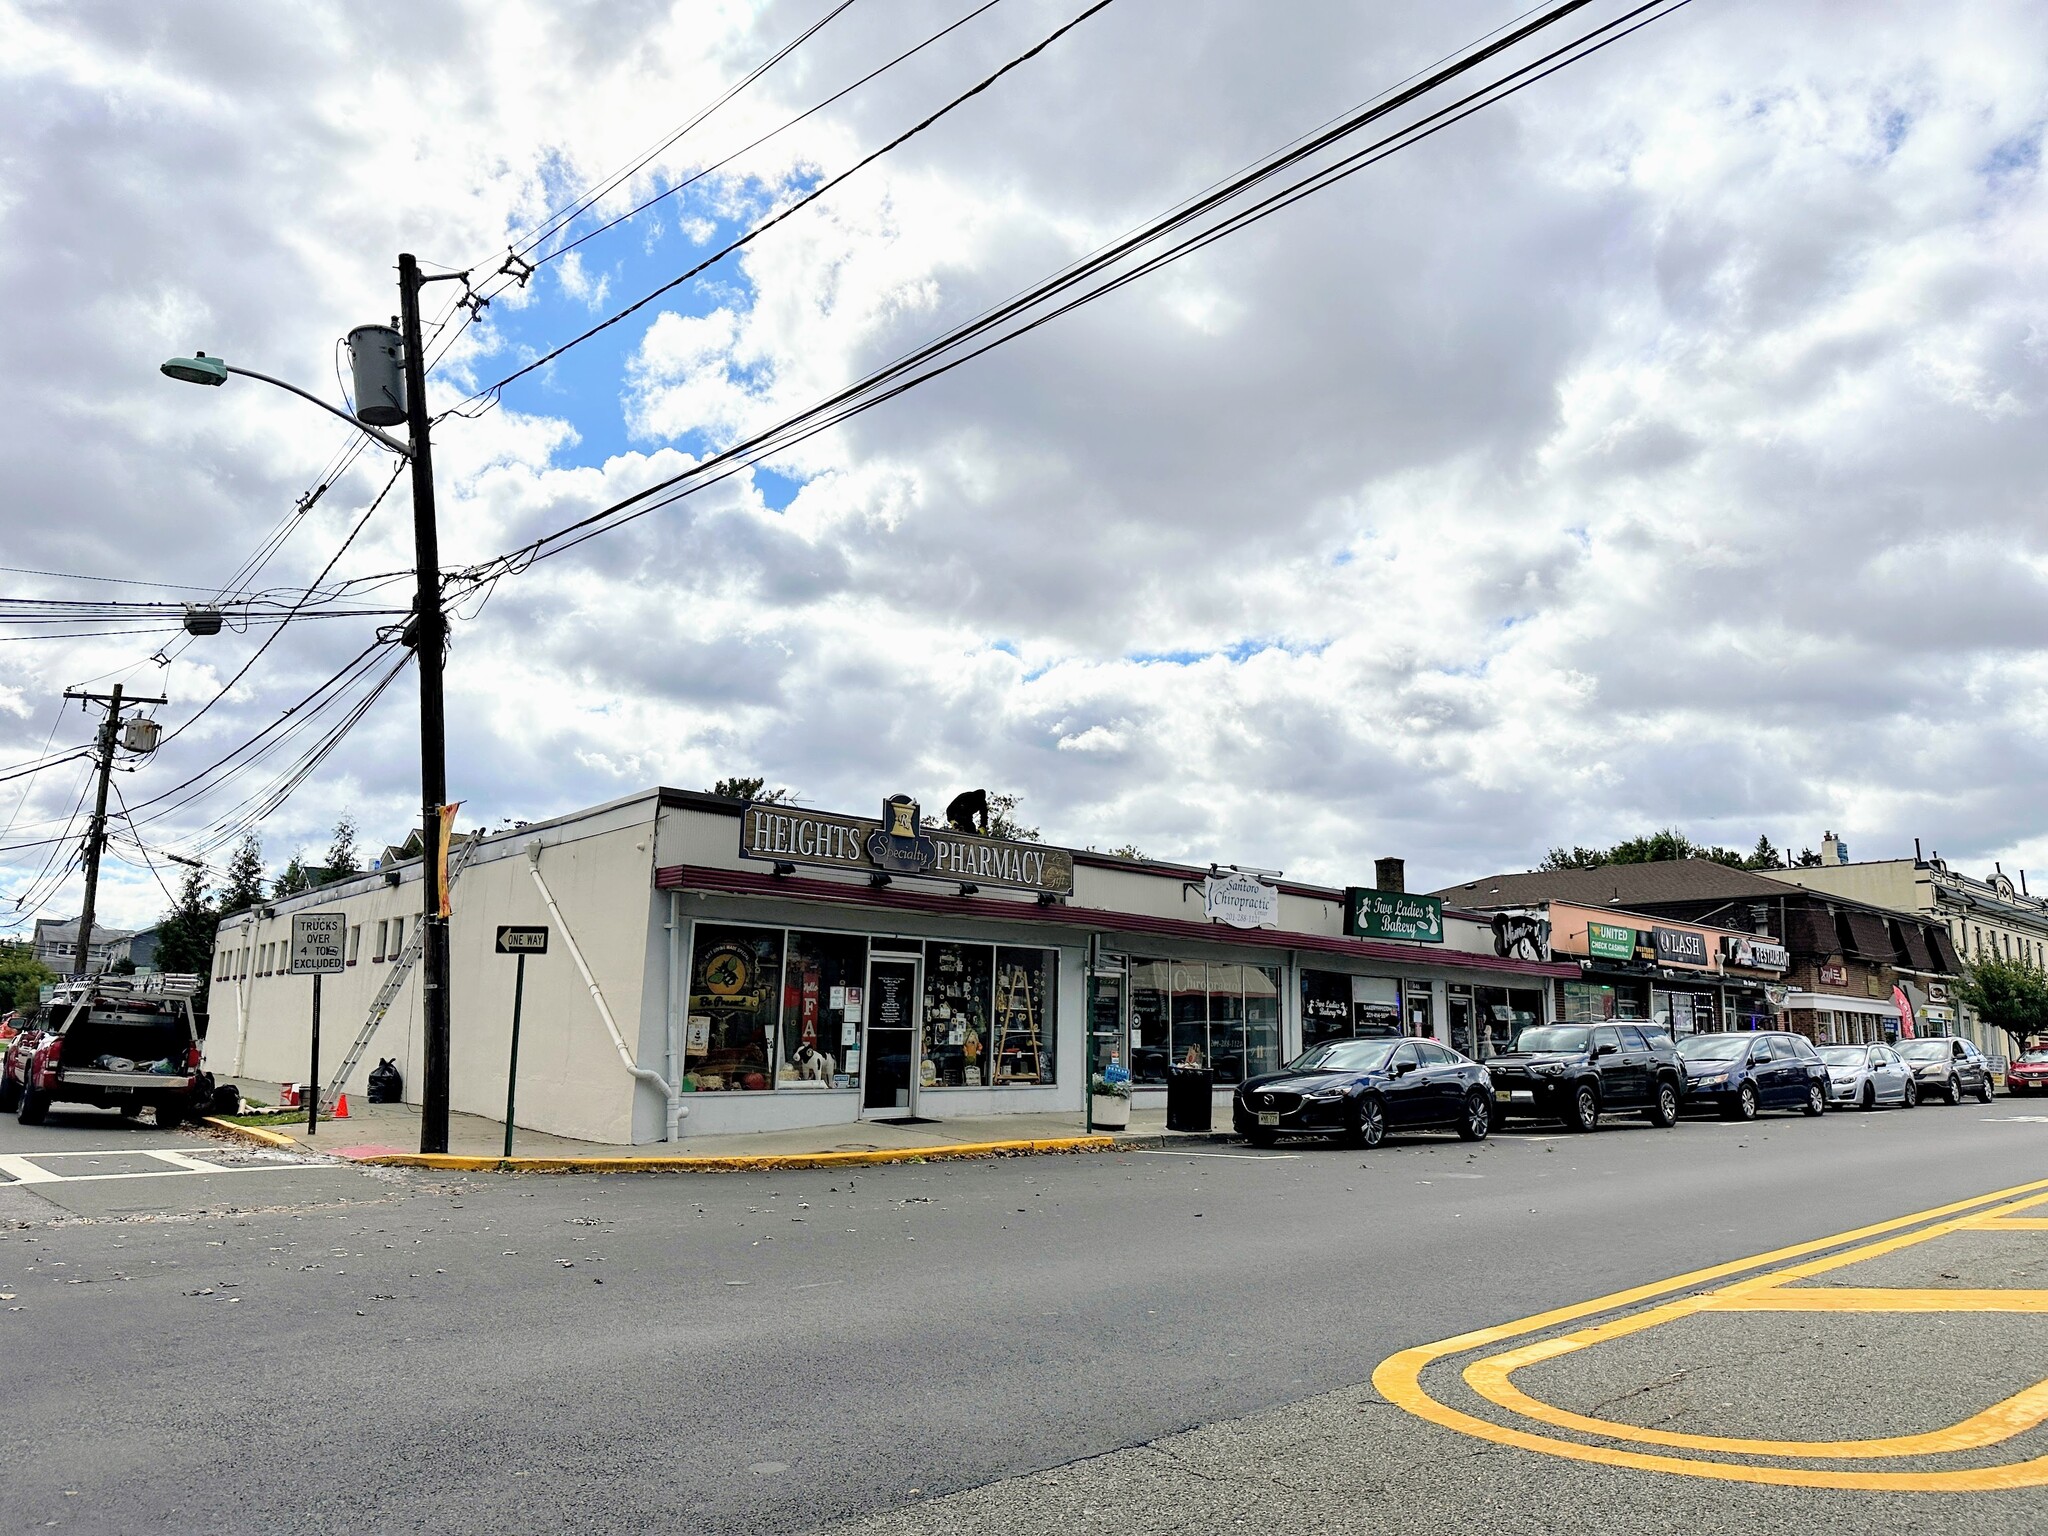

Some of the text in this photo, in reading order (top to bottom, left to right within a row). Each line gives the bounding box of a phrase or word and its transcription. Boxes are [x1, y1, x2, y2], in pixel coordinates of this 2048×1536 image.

[752, 810, 860, 860] HEIGHTS
[874, 836, 928, 866] Specialty
[936, 840, 1045, 886] PHARMACY
[1226, 879, 1259, 894] Santoro
[1214, 889, 1269, 911] Chiropractic
[1373, 897, 1424, 918] Two Ladies
[301, 921, 338, 931] TRUCKS
[1381, 914, 1417, 938] Bakery
[1600, 926, 1628, 940] UNITED
[307, 934, 330, 943] OVER
[508, 934, 543, 946] ONE WAY
[1591, 940, 1608, 950] CHECK
[1608, 943, 1630, 953] CASHING
[1671, 934, 1700, 956] LASH
[300, 946, 307, 956] 4
[1756, 947, 1790, 967] RESTAURANT
[294, 958, 341, 968] EXCLUDED
